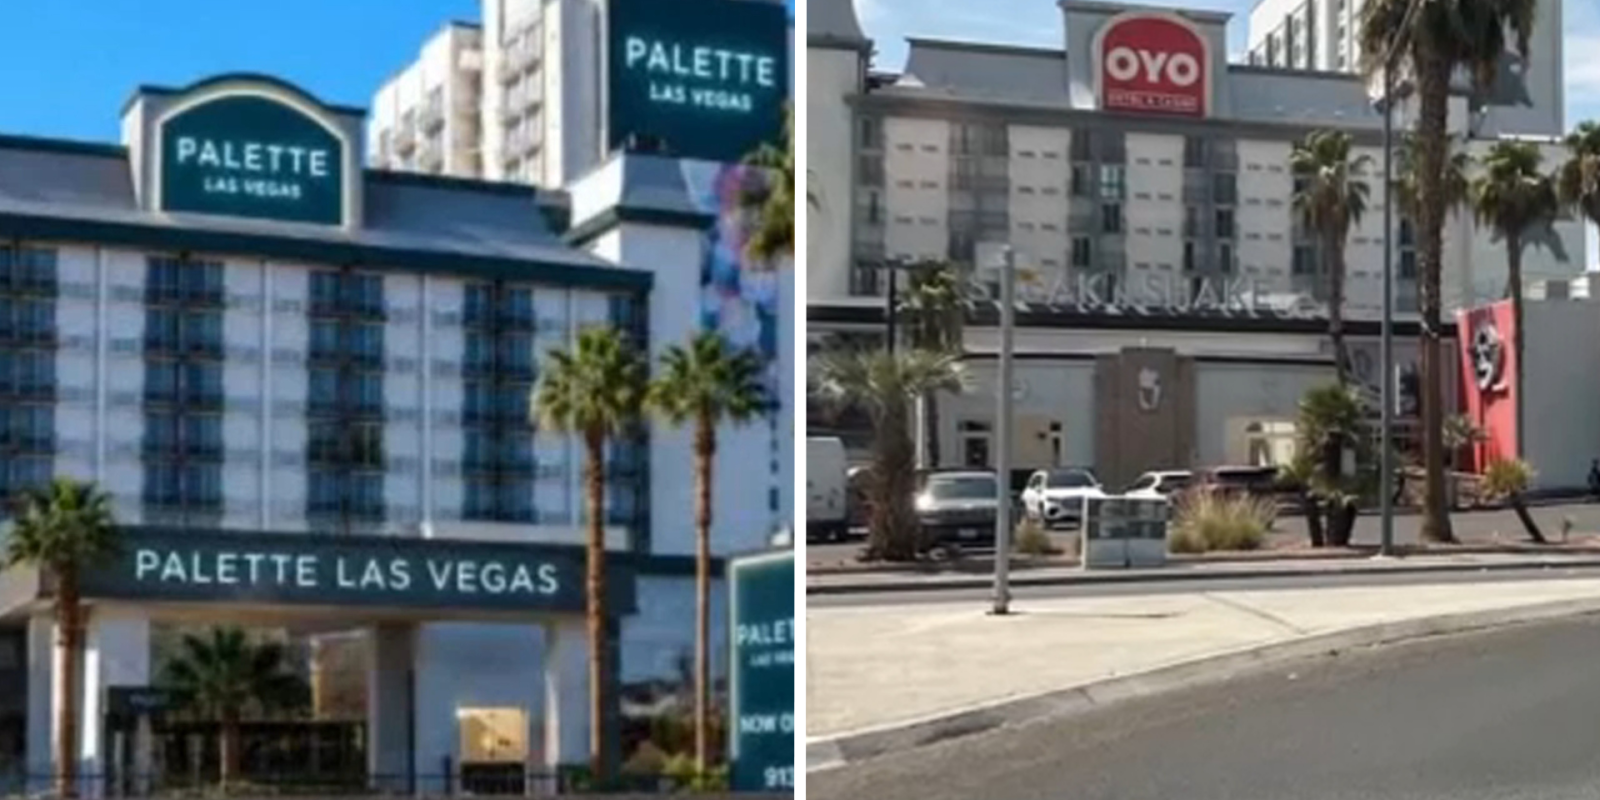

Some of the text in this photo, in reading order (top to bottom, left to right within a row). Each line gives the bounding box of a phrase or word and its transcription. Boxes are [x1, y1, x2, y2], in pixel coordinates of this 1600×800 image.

[626, 37, 775, 87] PALETTE
[1106, 46, 1200, 87] OYO
[649, 83, 753, 112] LAS VEGAS
[177, 136, 329, 176] PALETTE
[204, 177, 302, 199] LAS VEGAS
[136, 550, 559, 594] PALETTE LAS VEGAS
